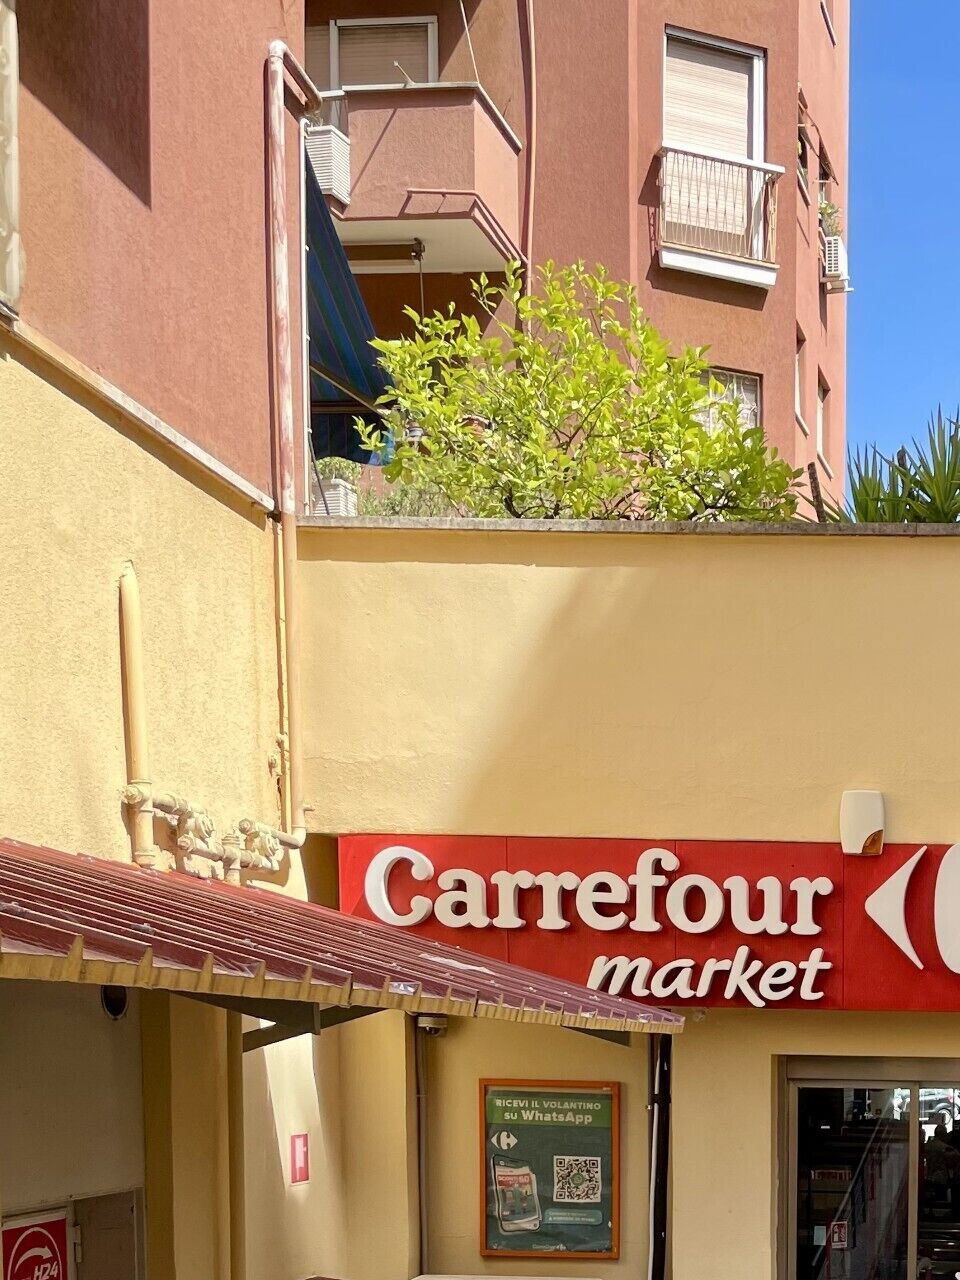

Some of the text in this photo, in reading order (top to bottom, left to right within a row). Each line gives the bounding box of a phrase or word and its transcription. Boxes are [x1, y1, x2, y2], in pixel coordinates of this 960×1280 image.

[363, 845, 834, 936] Carrefour
[586, 945, 834, 1007] market
[495, 1099, 601, 1110] RICEVI IL VOLANTINO
[521, 1110, 592, 1124] WhatsApp
